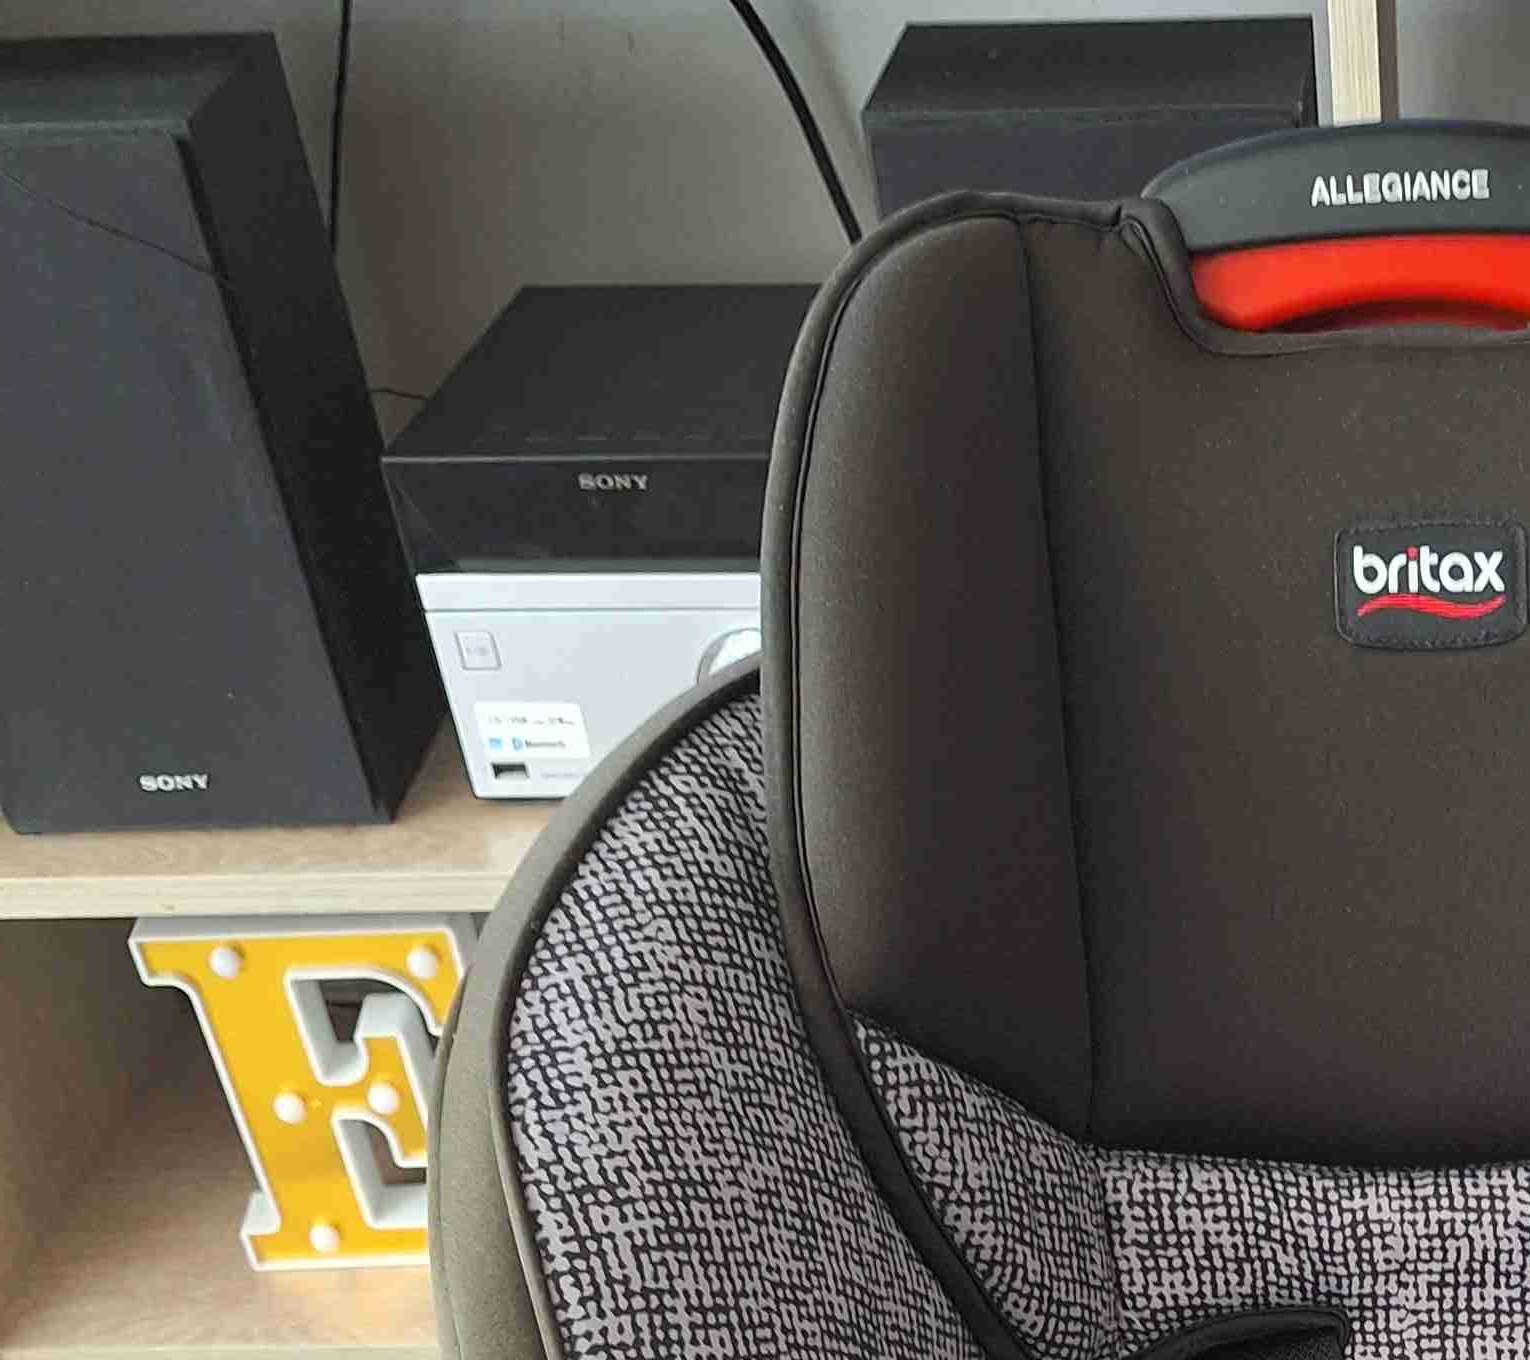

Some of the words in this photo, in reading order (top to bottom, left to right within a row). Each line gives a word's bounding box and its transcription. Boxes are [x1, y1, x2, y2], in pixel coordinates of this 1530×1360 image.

[1311, 168, 1491, 208] ALLEGIANCE
[578, 472, 649, 493] SONY
[1352, 544, 1506, 595] britax
[139, 771, 210, 793] SONY
